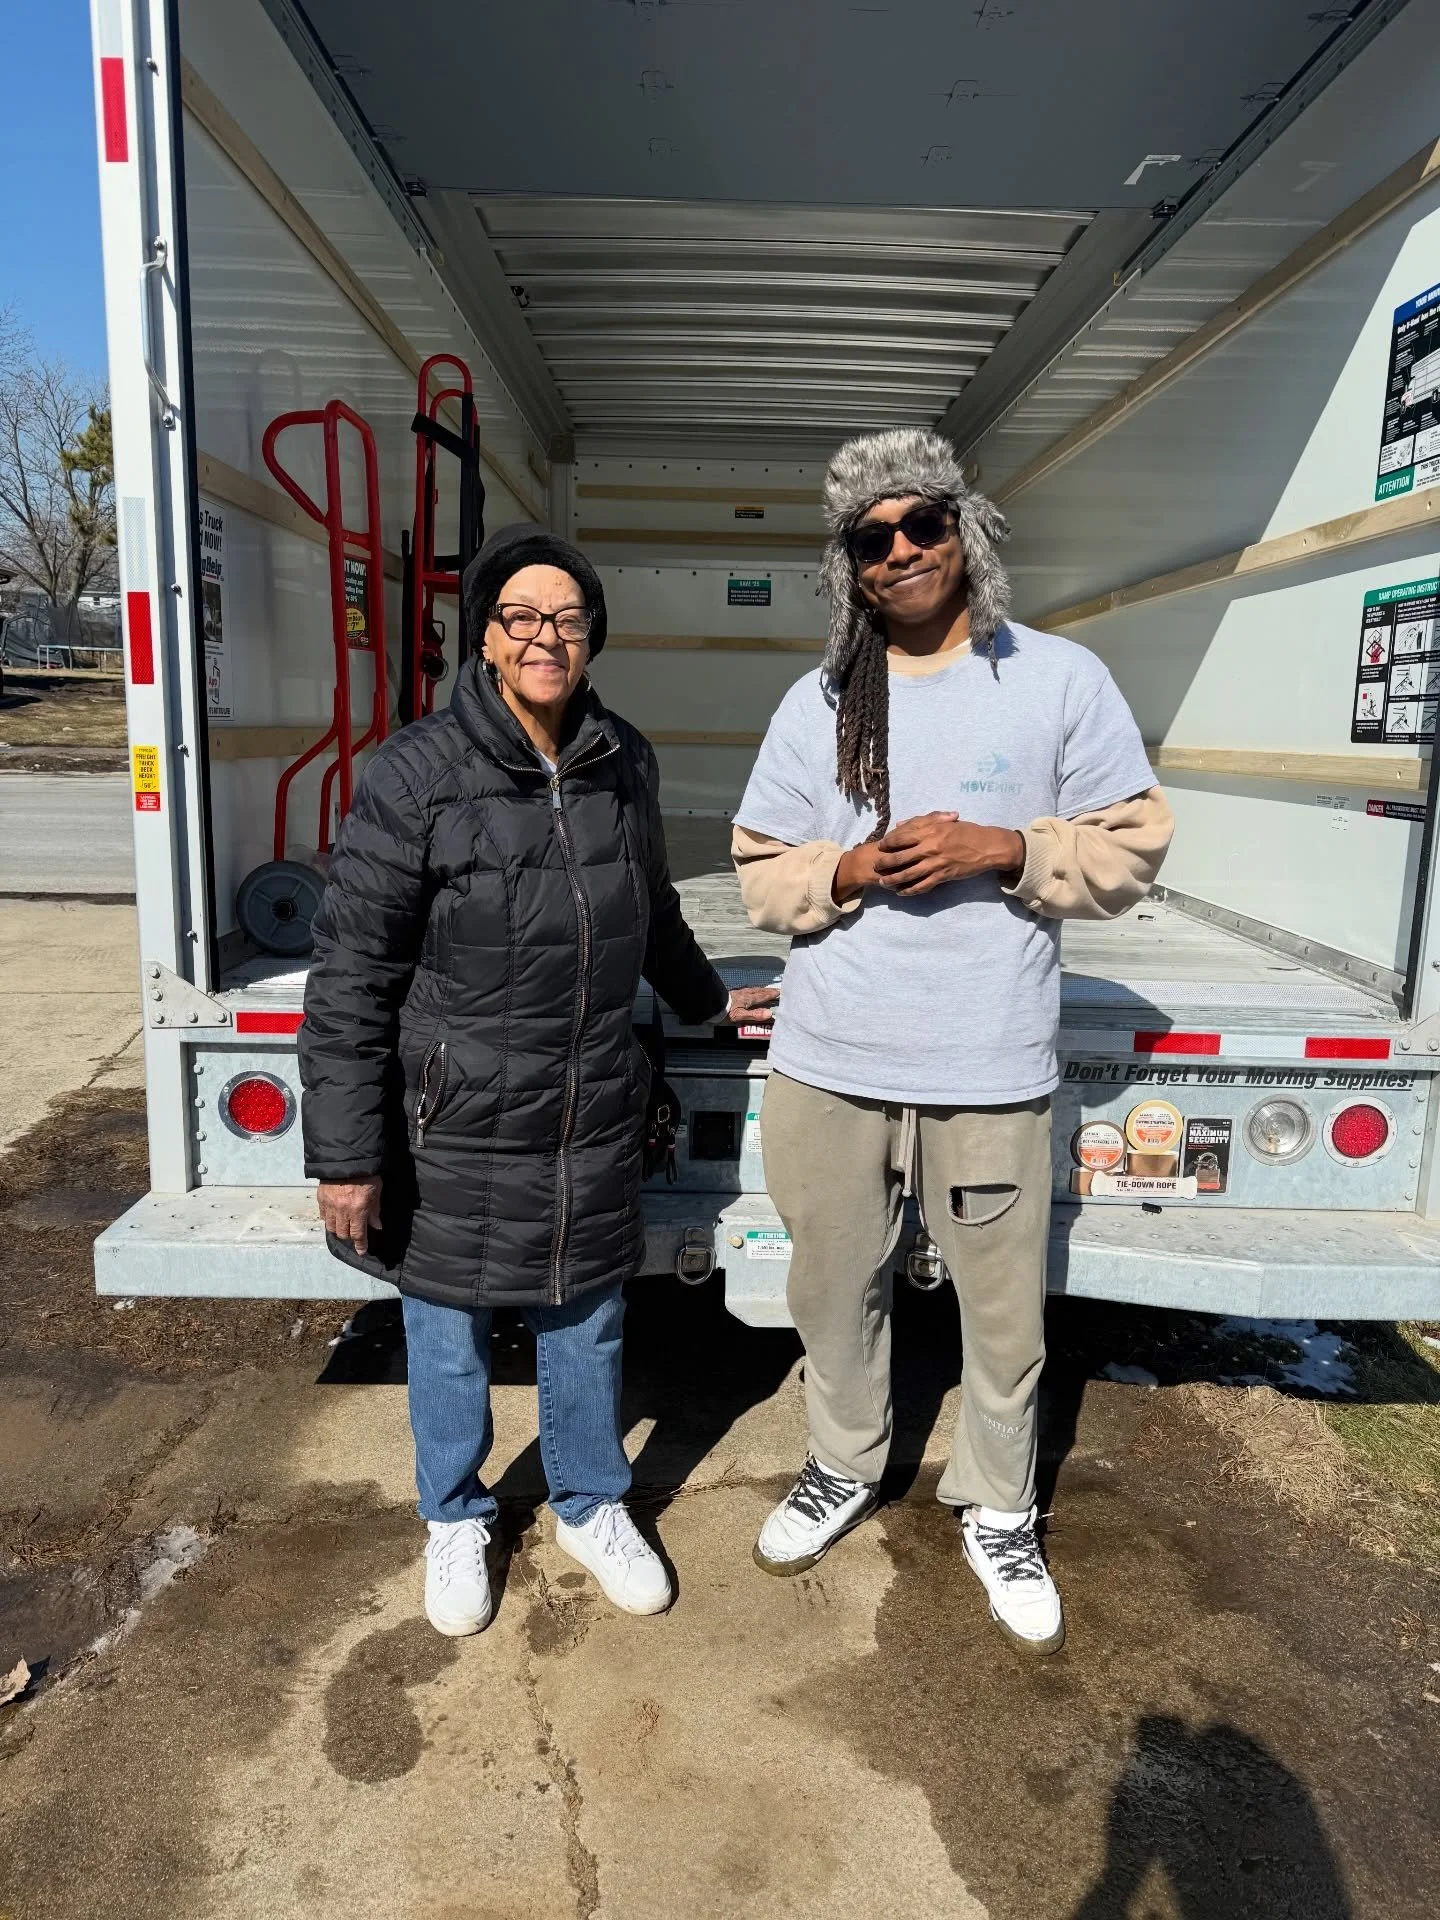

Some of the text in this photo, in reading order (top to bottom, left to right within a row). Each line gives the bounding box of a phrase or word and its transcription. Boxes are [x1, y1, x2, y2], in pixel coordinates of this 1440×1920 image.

[1378, 476, 1410, 495] ATTENTION
[205, 510, 223, 532] Truck
[204, 531, 221, 552] NOW!
[351, 560, 366, 576] NOW!
[1392, 586, 1416, 598] OPERATING
[1368, 804, 1384, 813] DANGER
[1064, 1062, 1418, 1090] Don't Forget Your Moving Supplies!
